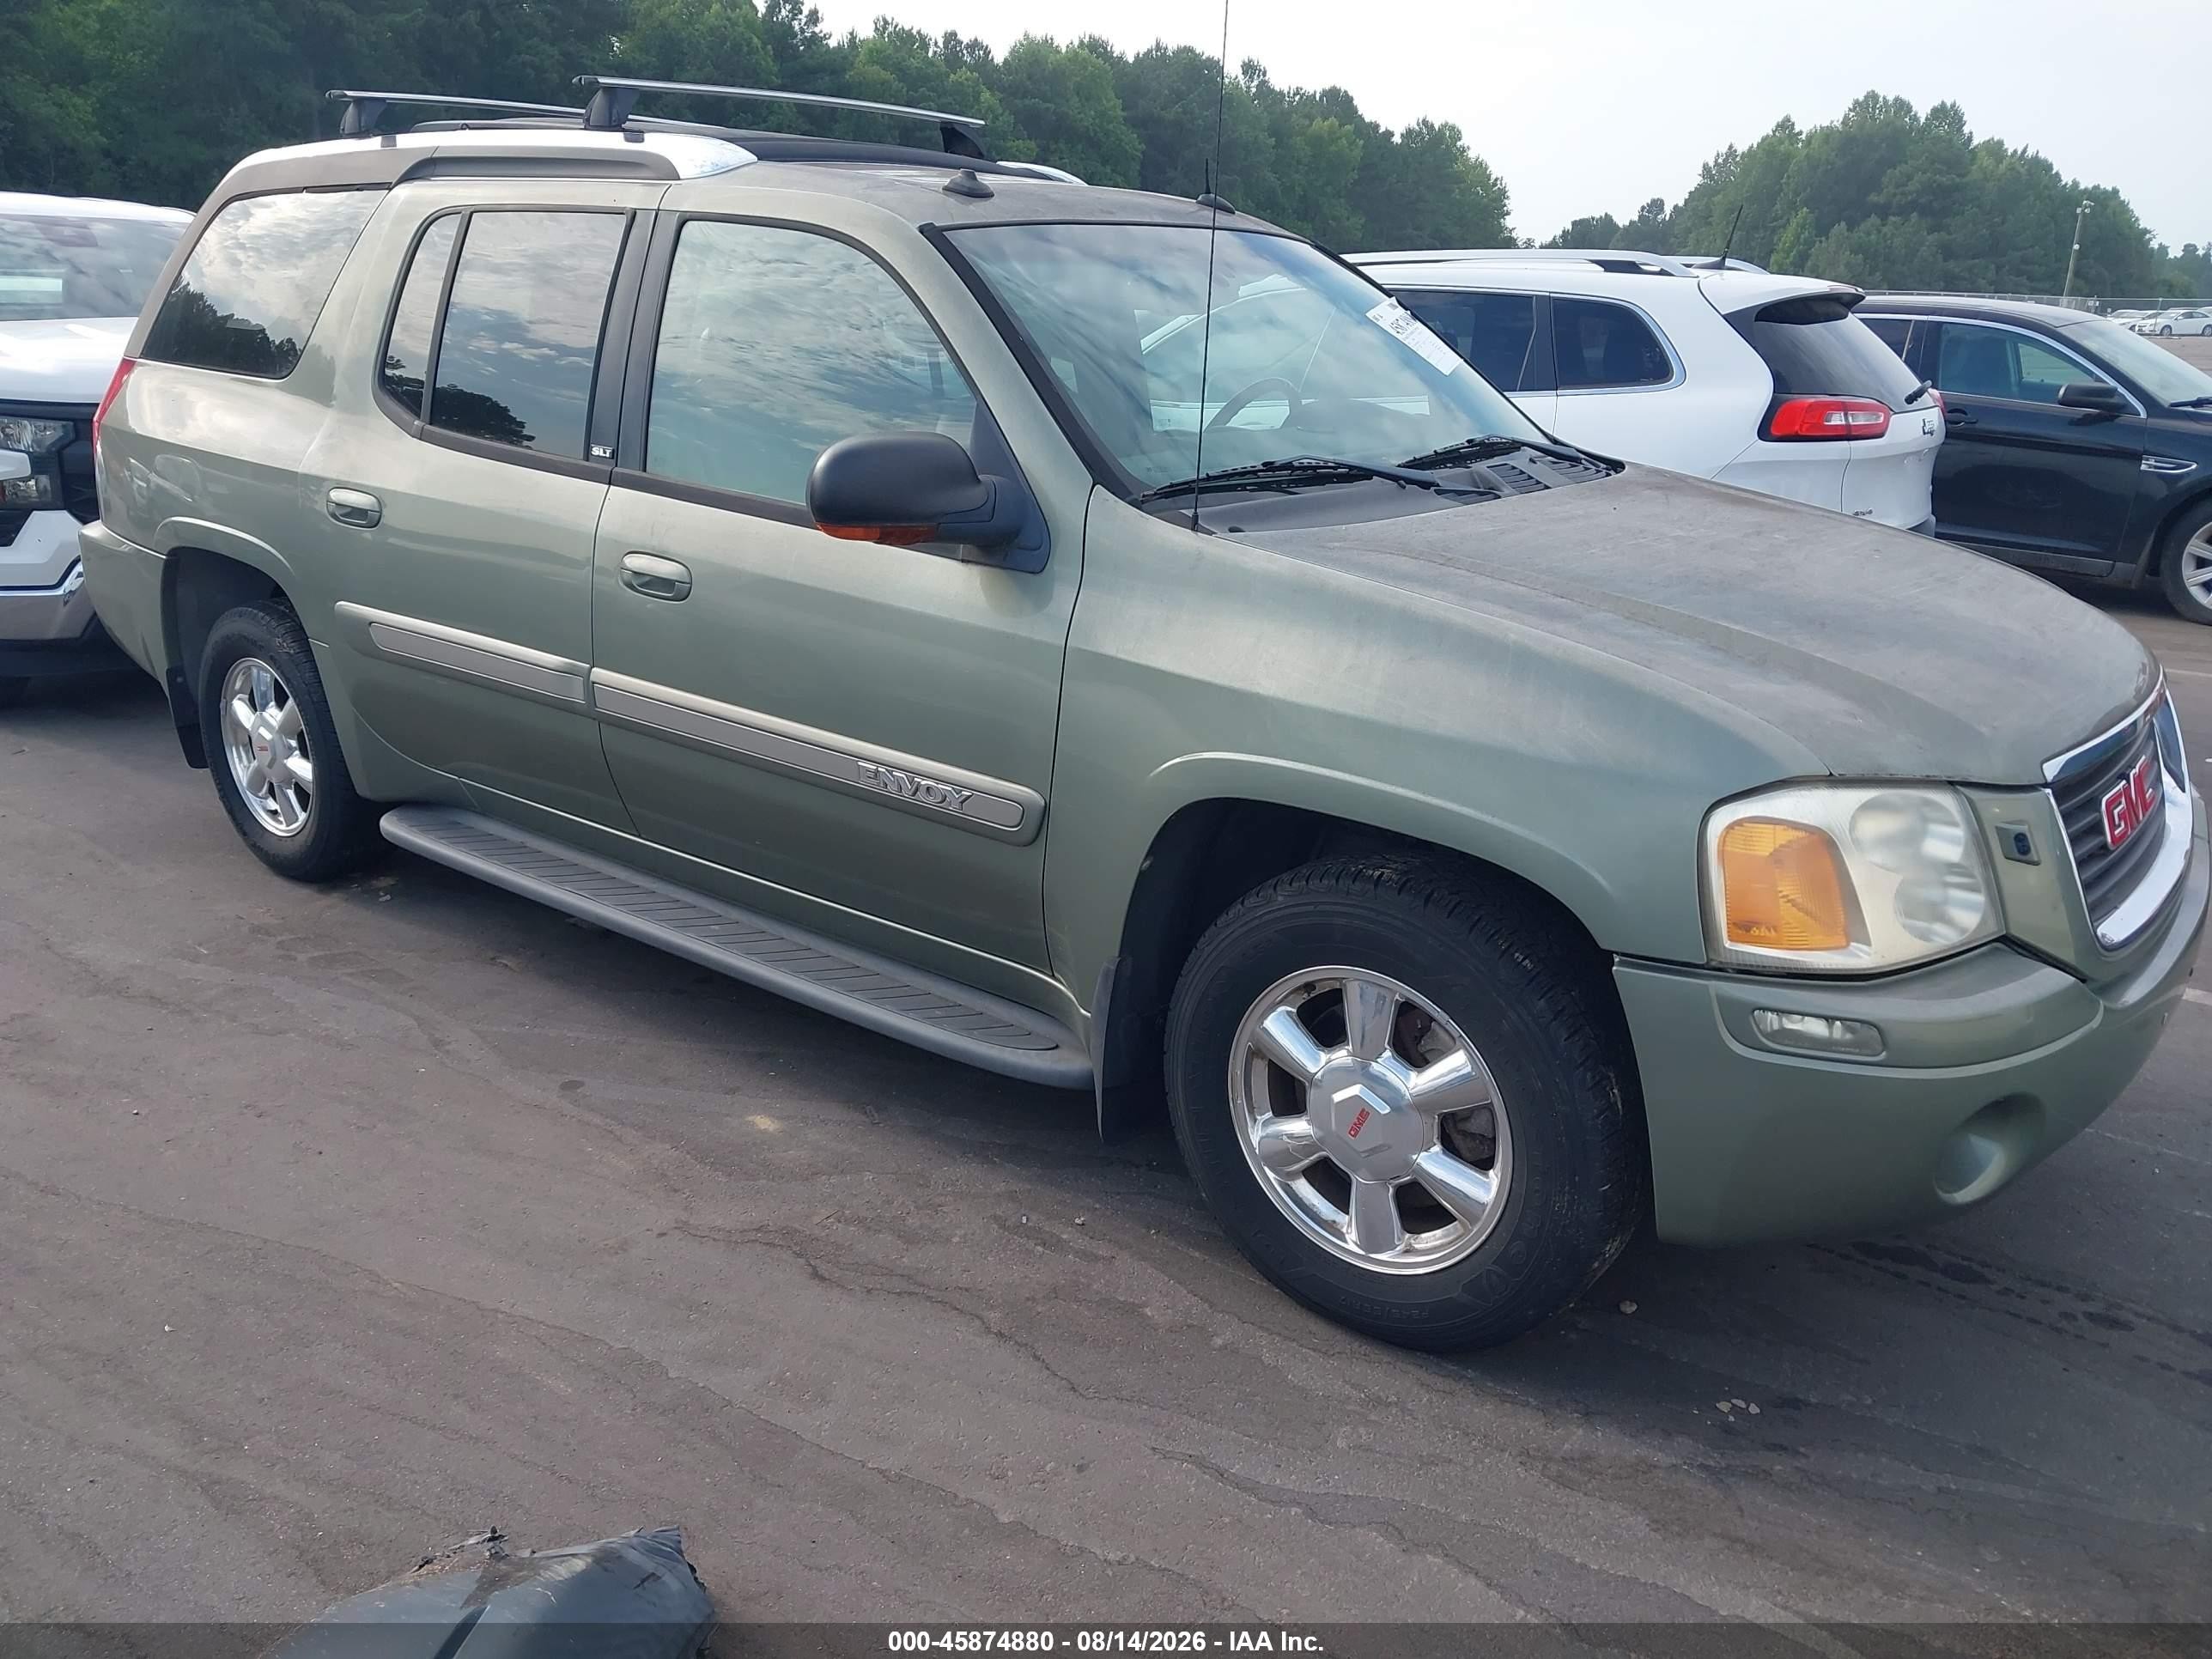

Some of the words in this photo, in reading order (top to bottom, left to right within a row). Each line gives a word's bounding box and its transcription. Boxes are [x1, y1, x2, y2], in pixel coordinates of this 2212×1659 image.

[591, 447, 611, 458] SLT
[856, 760, 973, 811] ENVOY
[2101, 754, 2157, 851] GMC
[1348, 1108, 1370, 1139] GMC
